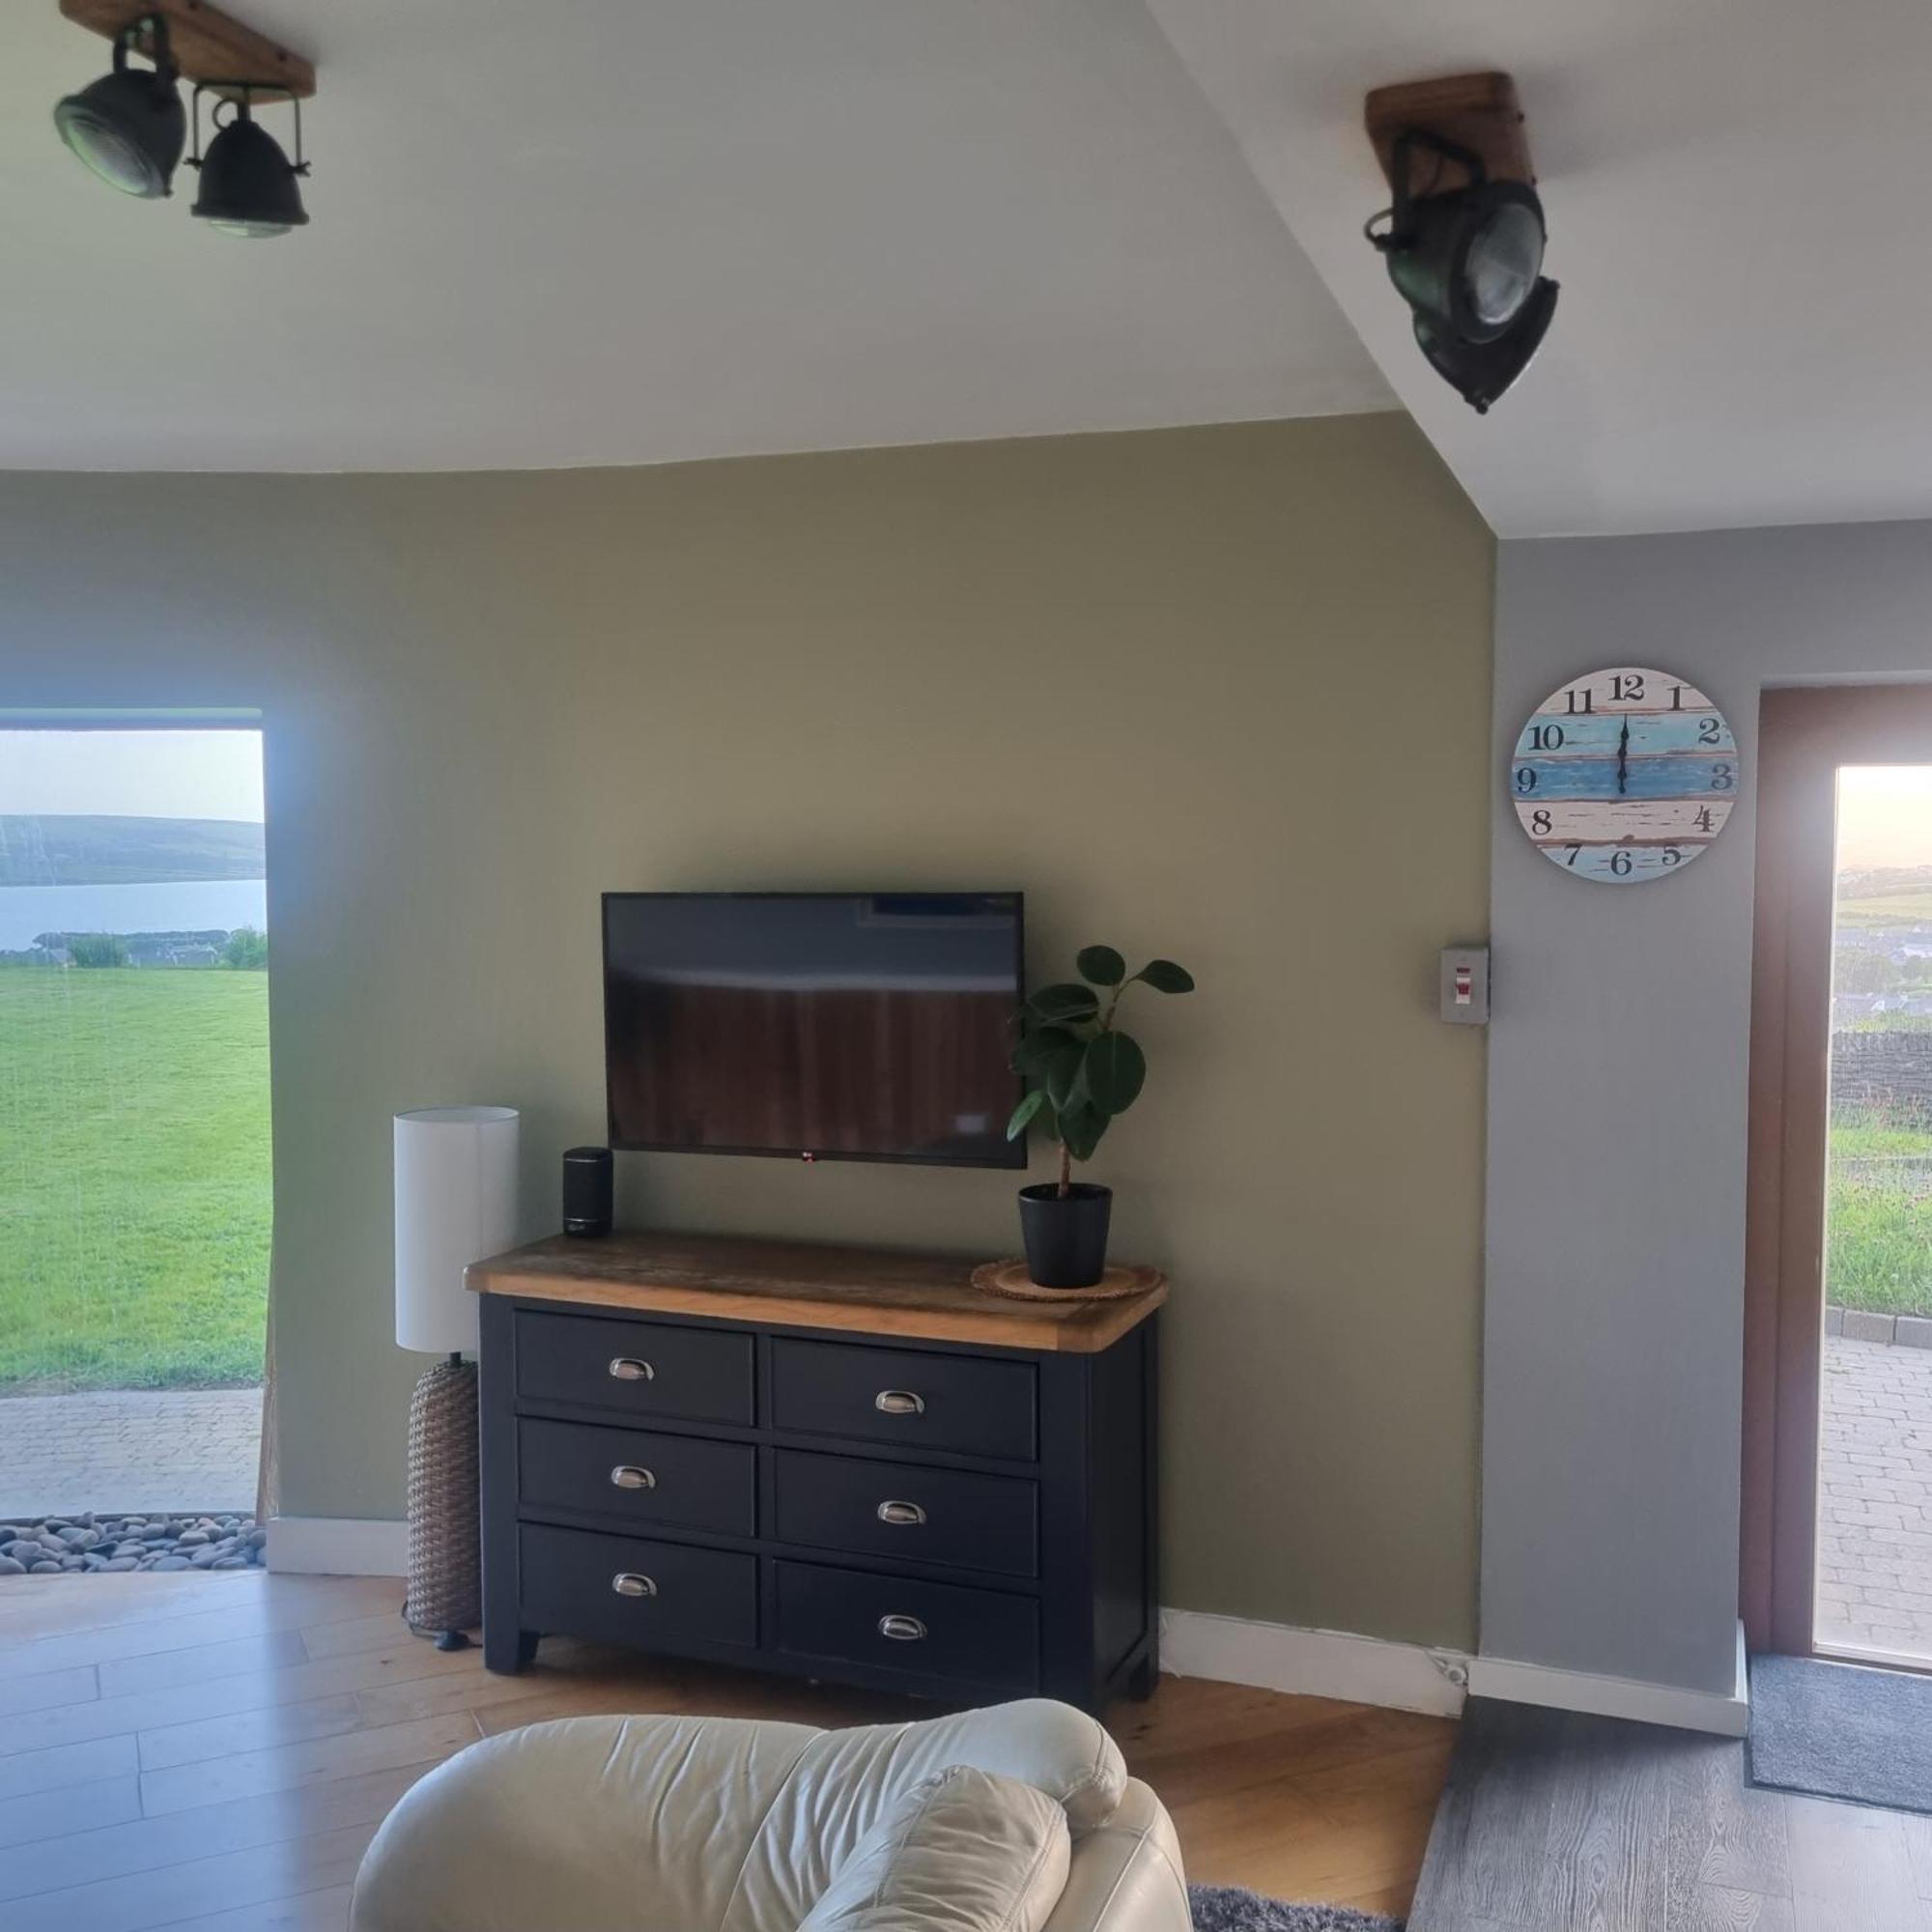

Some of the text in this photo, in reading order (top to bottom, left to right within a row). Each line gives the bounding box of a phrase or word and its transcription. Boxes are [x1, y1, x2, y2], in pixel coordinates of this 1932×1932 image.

[1608, 674, 1644, 700] 12
[1667, 686, 1685, 711] 1
[1564, 689, 1596, 715] 11
[1527, 724, 1564, 751] 10
[1698, 718, 1720, 744] 2
[1517, 767, 1537, 793] 9
[1711, 764, 1733, 790] 3
[1531, 810, 1552, 836] 8
[1692, 805, 1715, 833] 4
[1564, 843, 1582, 866] 7
[1610, 851, 1633, 875] 6
[1662, 843, 1682, 866] 5
